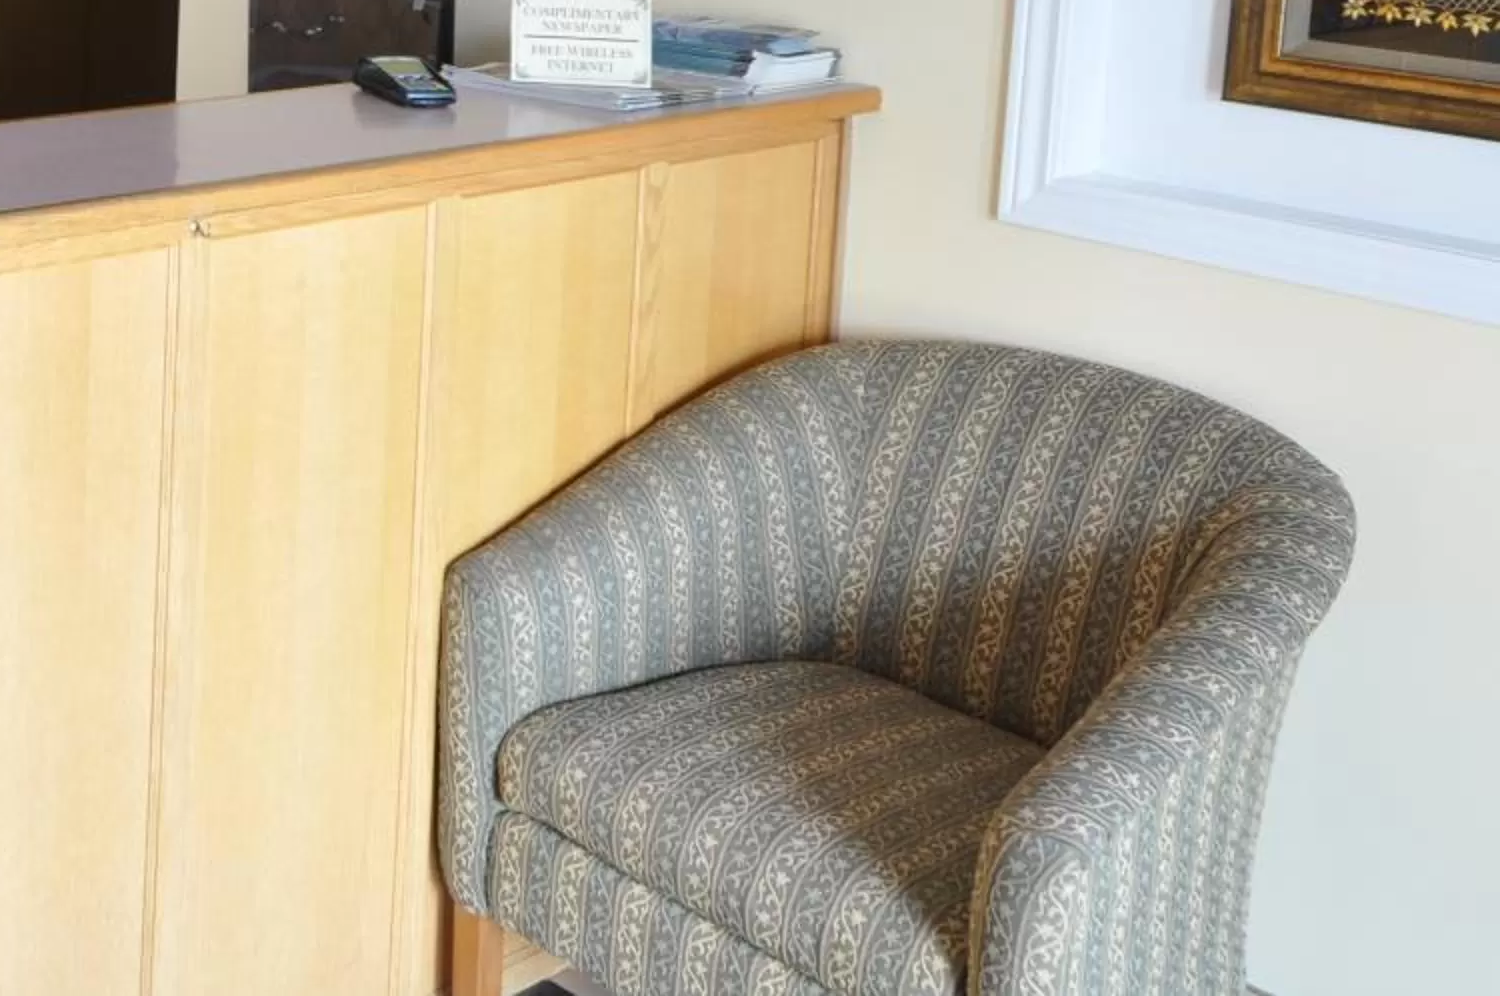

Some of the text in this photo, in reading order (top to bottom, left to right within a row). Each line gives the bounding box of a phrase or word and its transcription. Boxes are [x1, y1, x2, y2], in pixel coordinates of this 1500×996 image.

[522, 6, 640, 21] COMPLIMENTARY
[541, 19, 623, 34] NEWSPAPER
[530, 43, 634, 59] FREE WIRELESS
[547, 59, 614, 73] INTERNET
